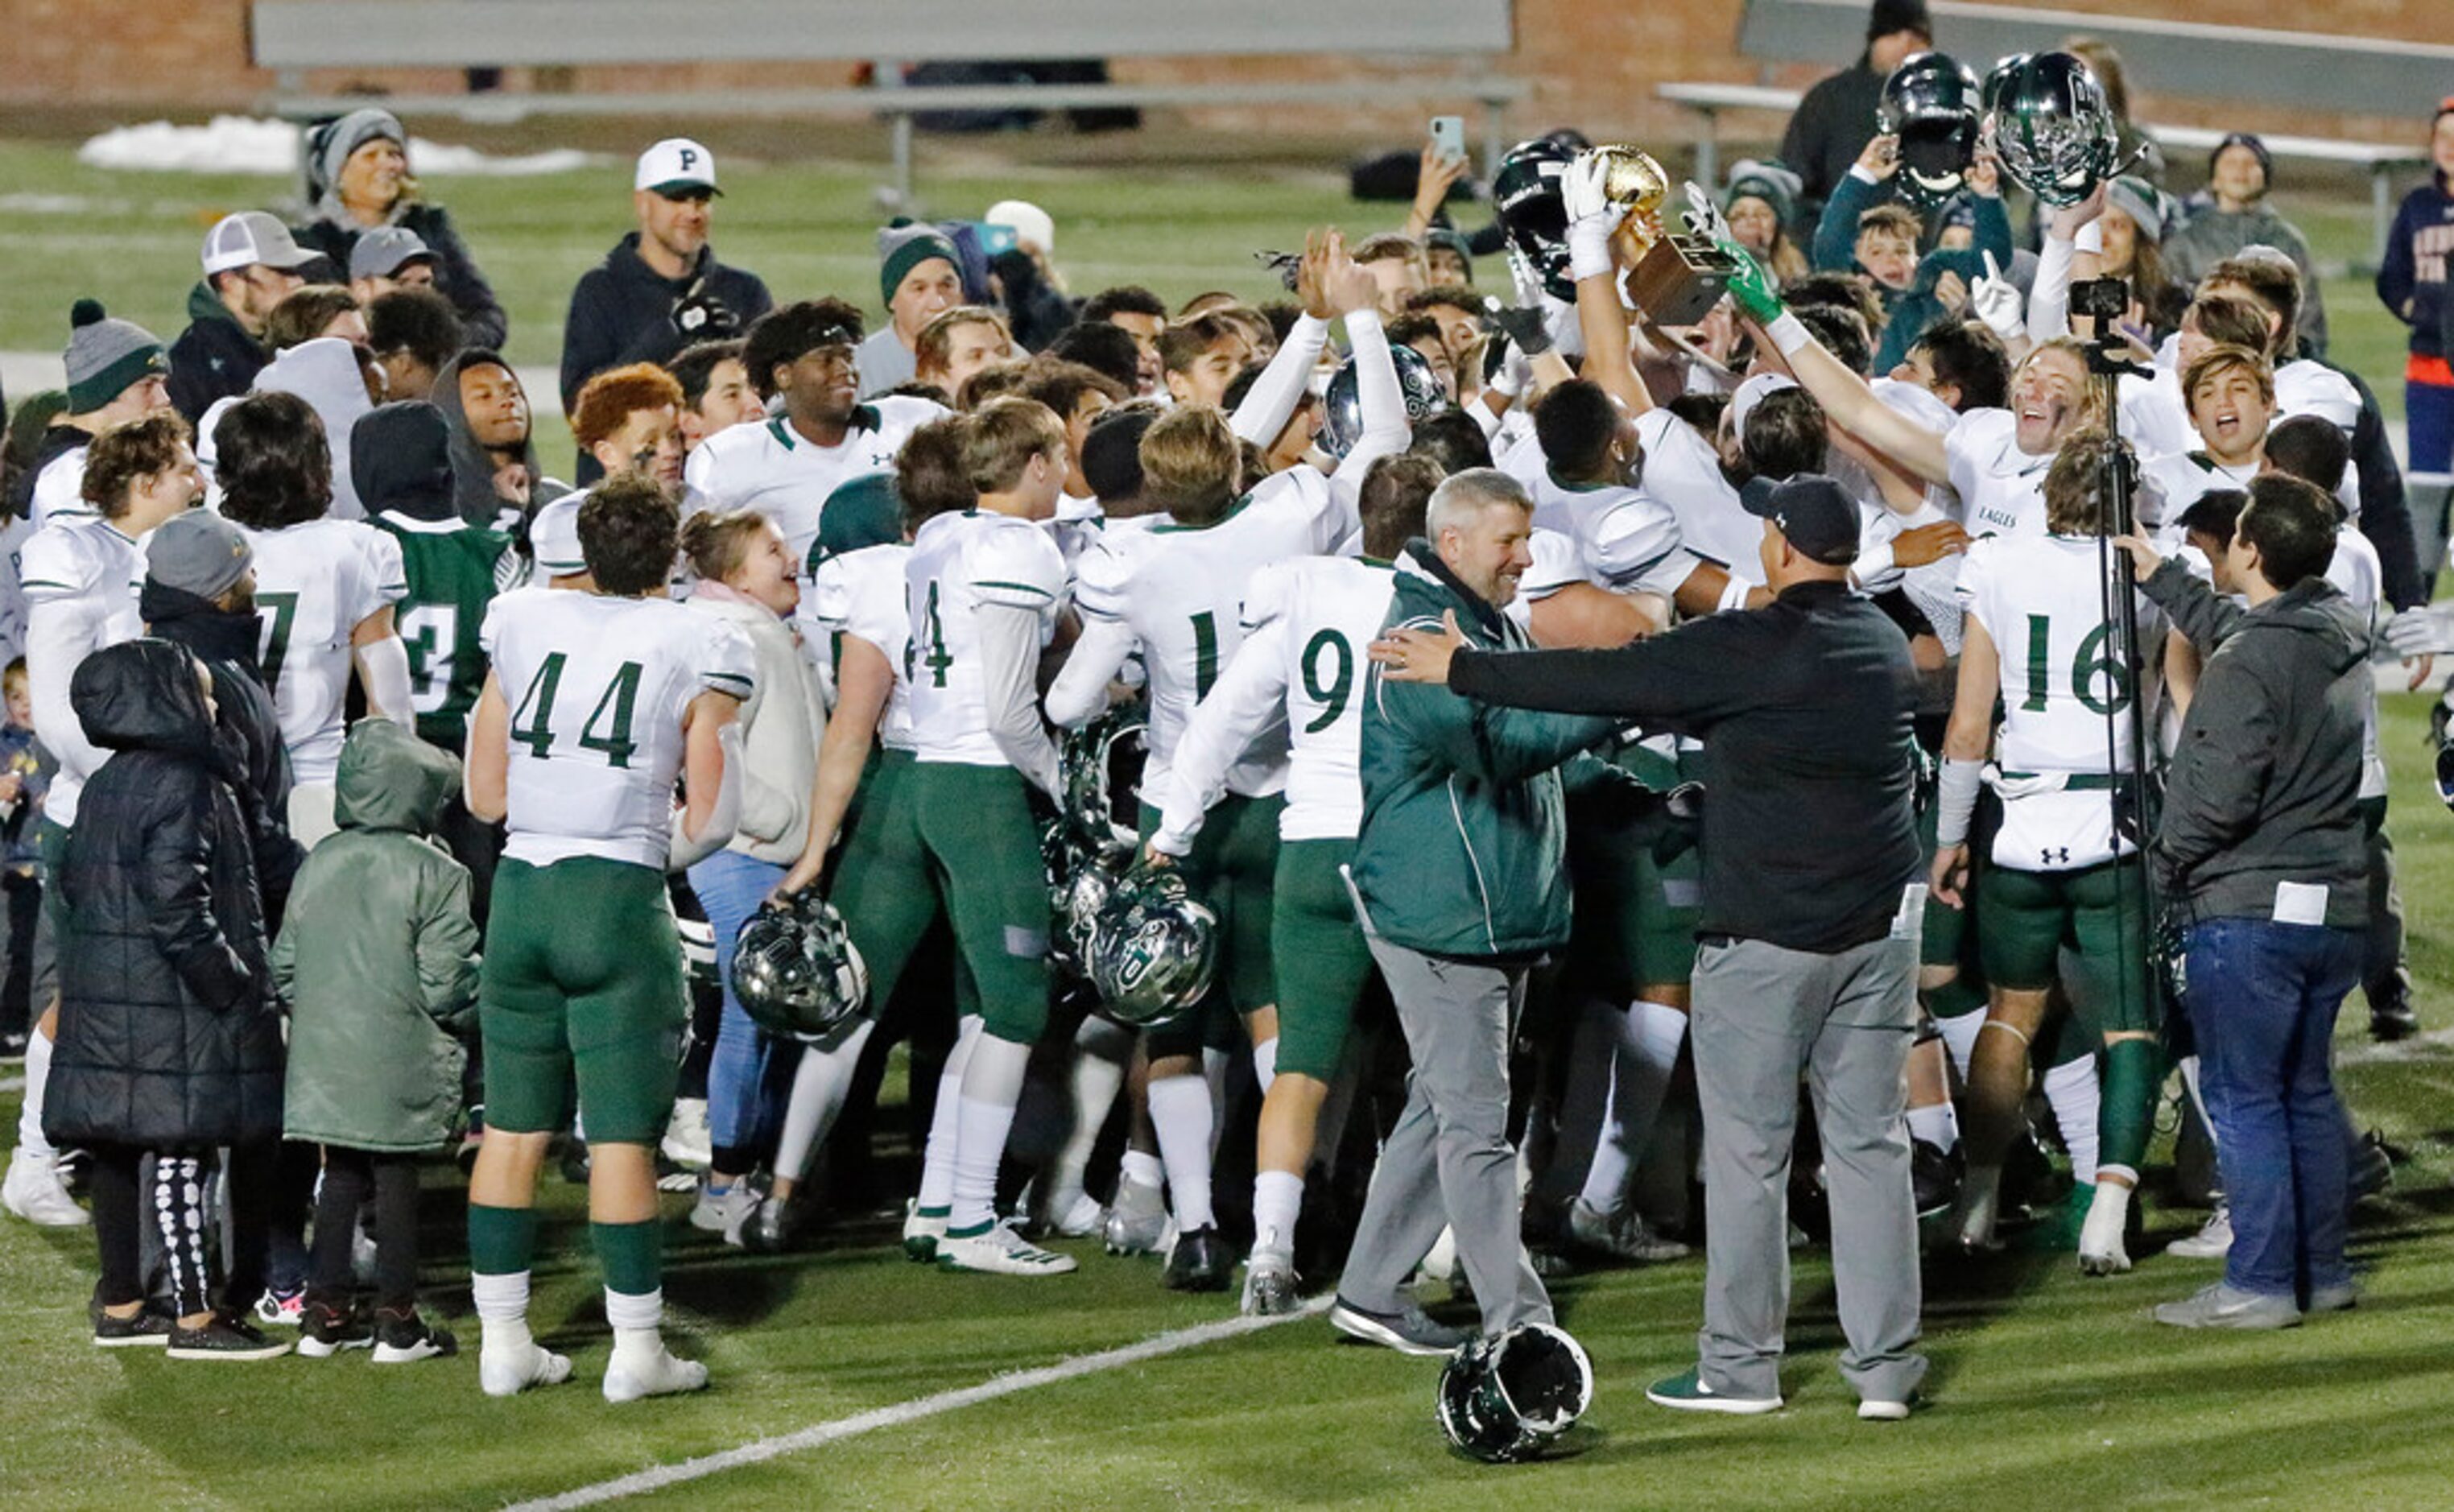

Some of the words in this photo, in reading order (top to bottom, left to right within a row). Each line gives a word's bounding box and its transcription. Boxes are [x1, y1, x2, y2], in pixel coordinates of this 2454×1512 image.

[680, 149, 697, 171] P
[1978, 506, 2016, 528] EAGLES
[402, 605, 457, 713] 3
[510, 651, 643, 770] 44
[1301, 627, 1353, 733] 9
[2020, 613, 2134, 715] 16
